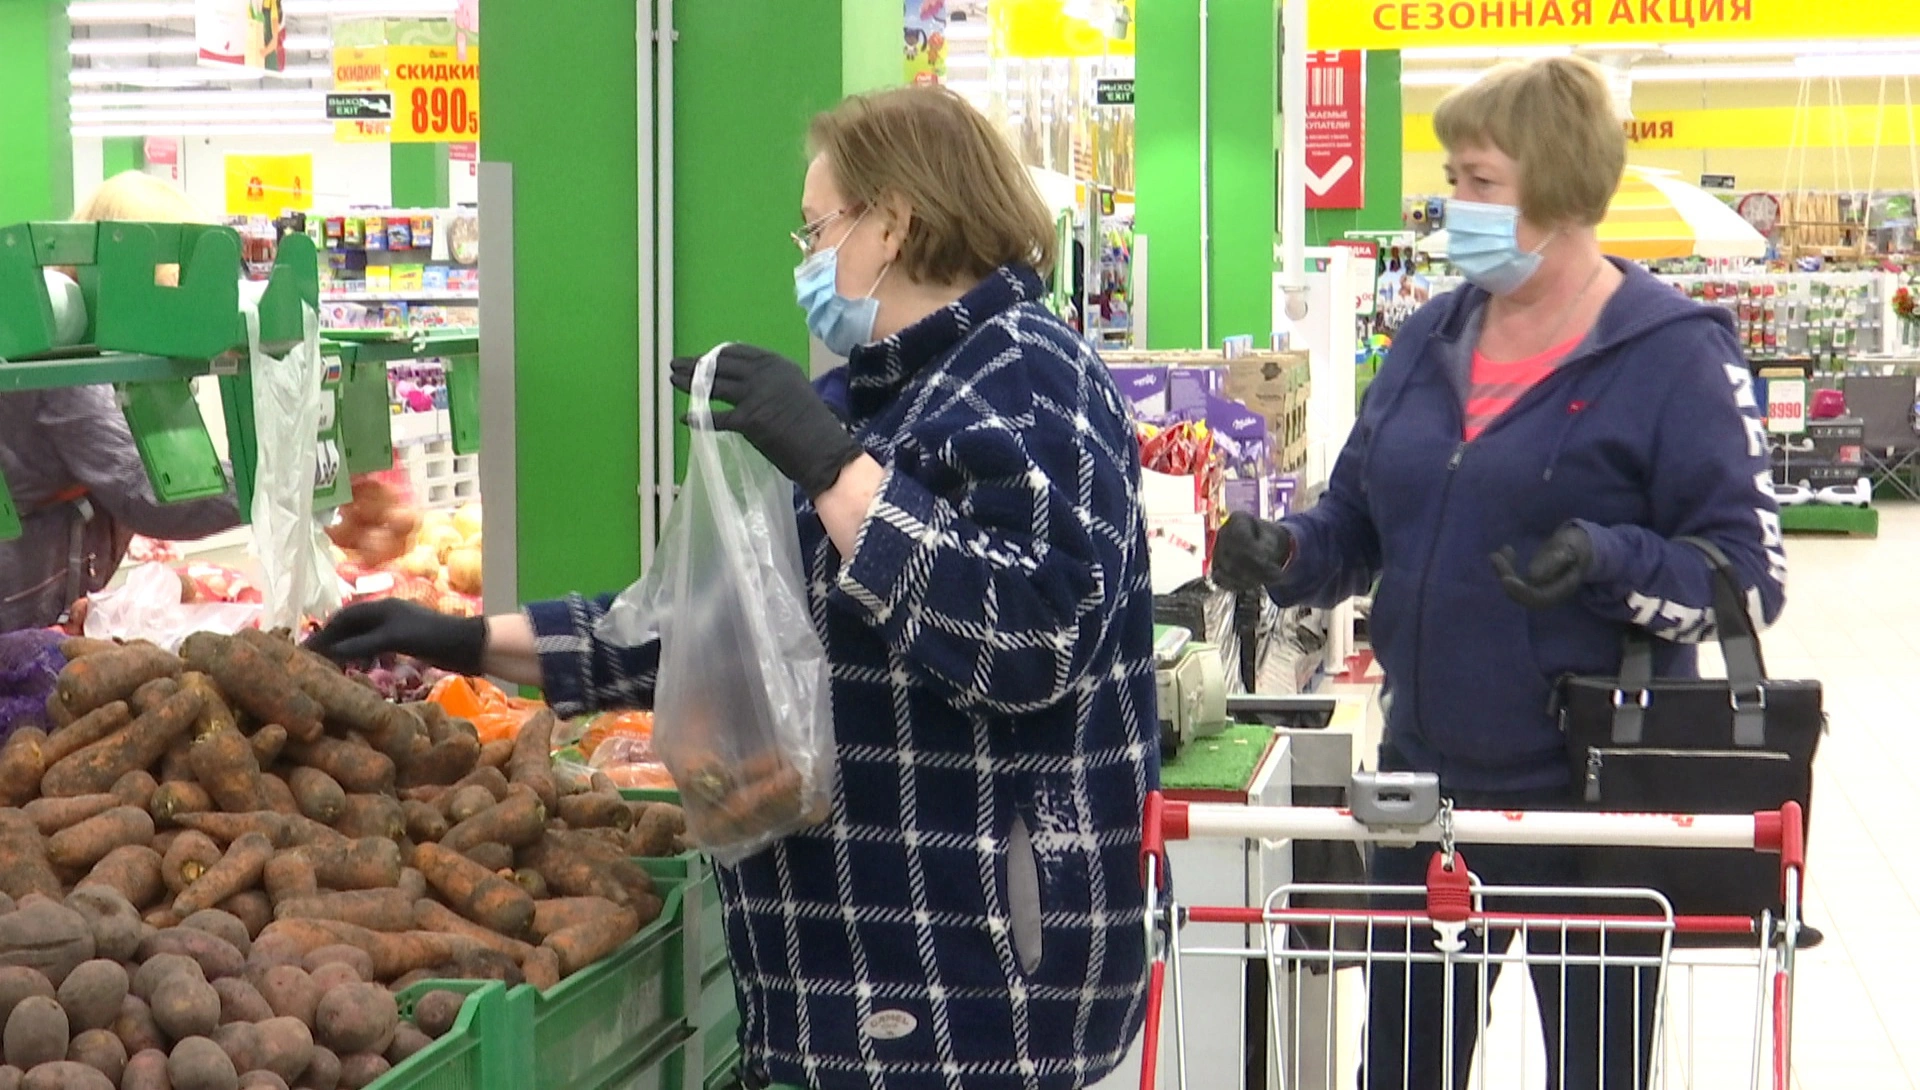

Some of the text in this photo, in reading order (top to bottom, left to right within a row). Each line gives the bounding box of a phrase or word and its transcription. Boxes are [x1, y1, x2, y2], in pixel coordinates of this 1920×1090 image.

[1372, 0, 1753, 31] СЕЗОННАЯ АКЦИЯ
[1106, 92, 1131, 101] EXIT
[336, 106, 359, 116] EXIT
[411, 86, 467, 134] 890
[1622, 121, 1673, 143] ЦИЯ
[1769, 402, 1801, 419] 8990
